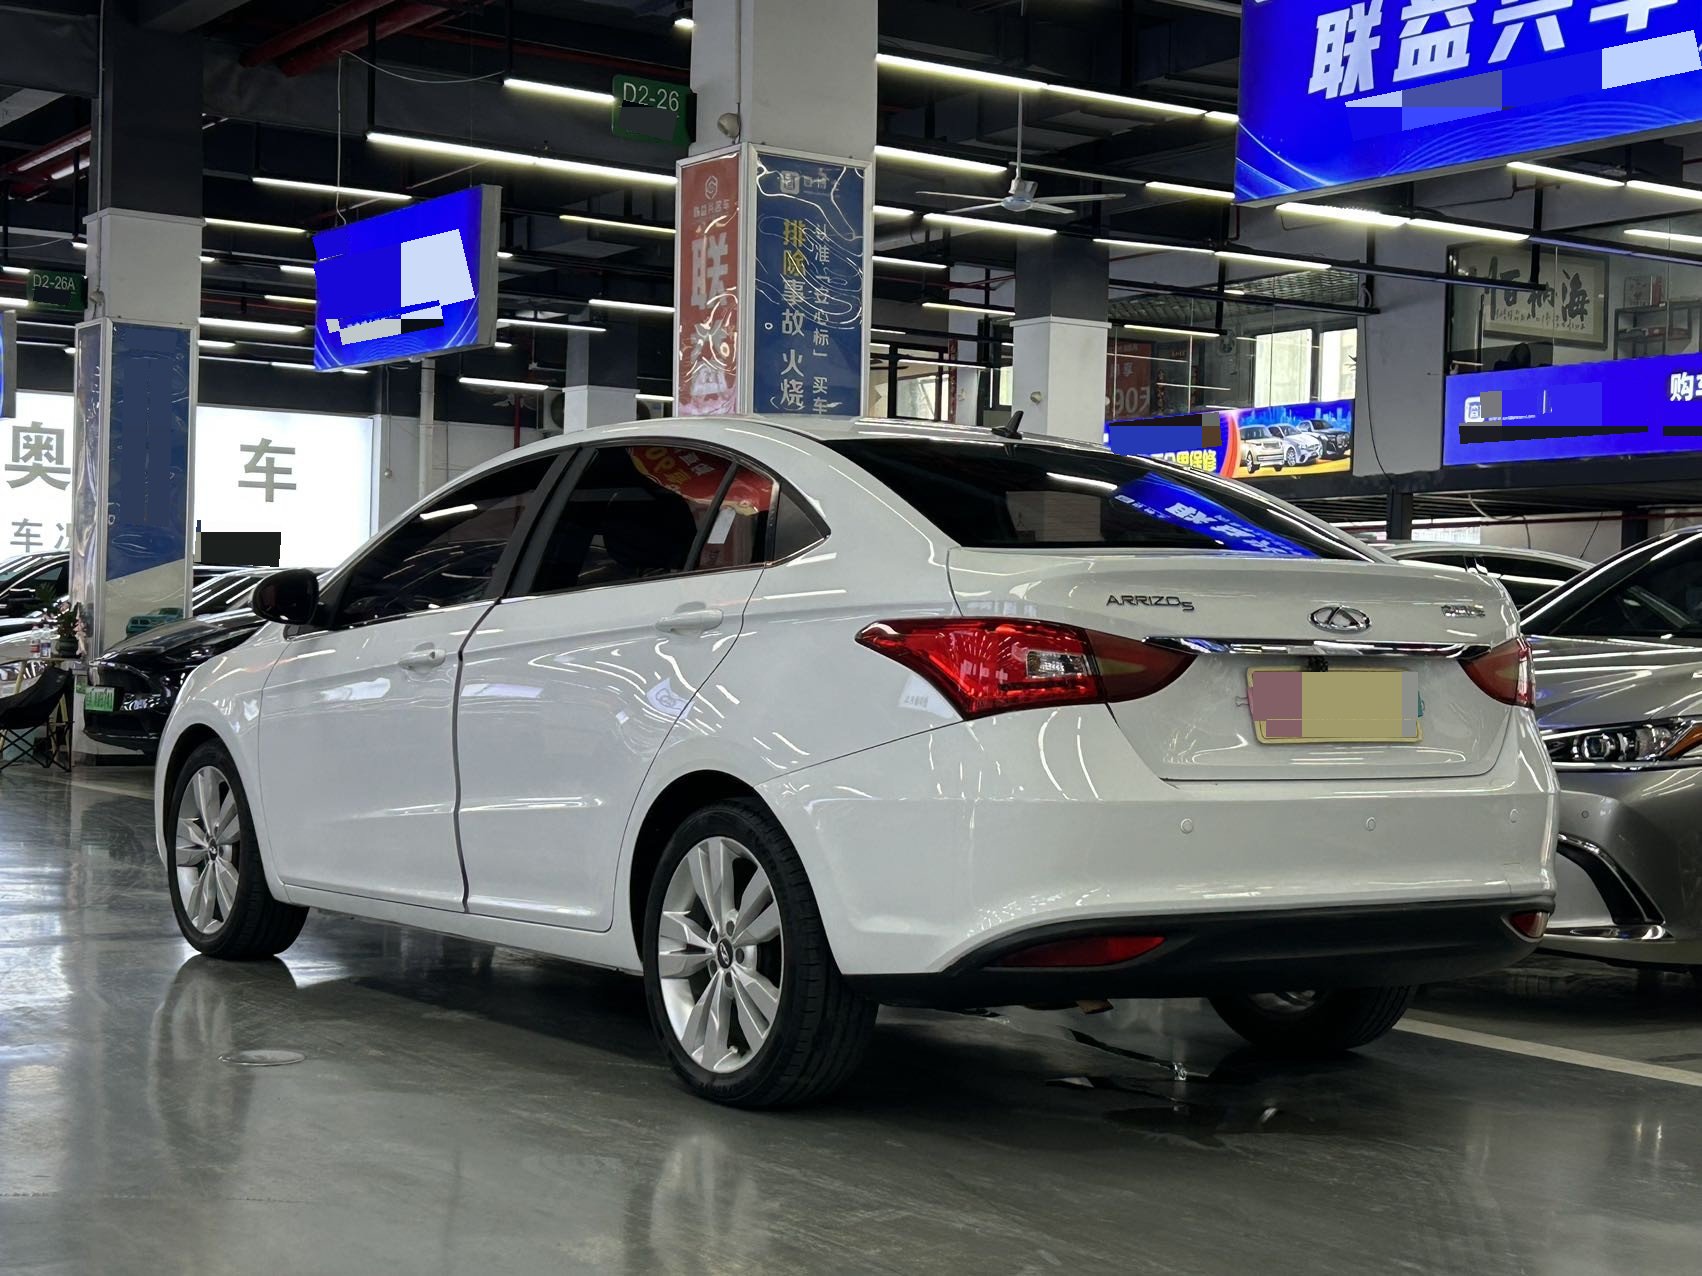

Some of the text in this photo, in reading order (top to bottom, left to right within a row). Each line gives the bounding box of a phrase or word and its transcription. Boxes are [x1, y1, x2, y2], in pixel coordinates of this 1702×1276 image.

[623, 82, 680, 112] D2-26
[33, 274, 76, 290] D2-26A
[1669, 371, 1702, 402] 购
[4, 421, 297, 503] 奥 车
